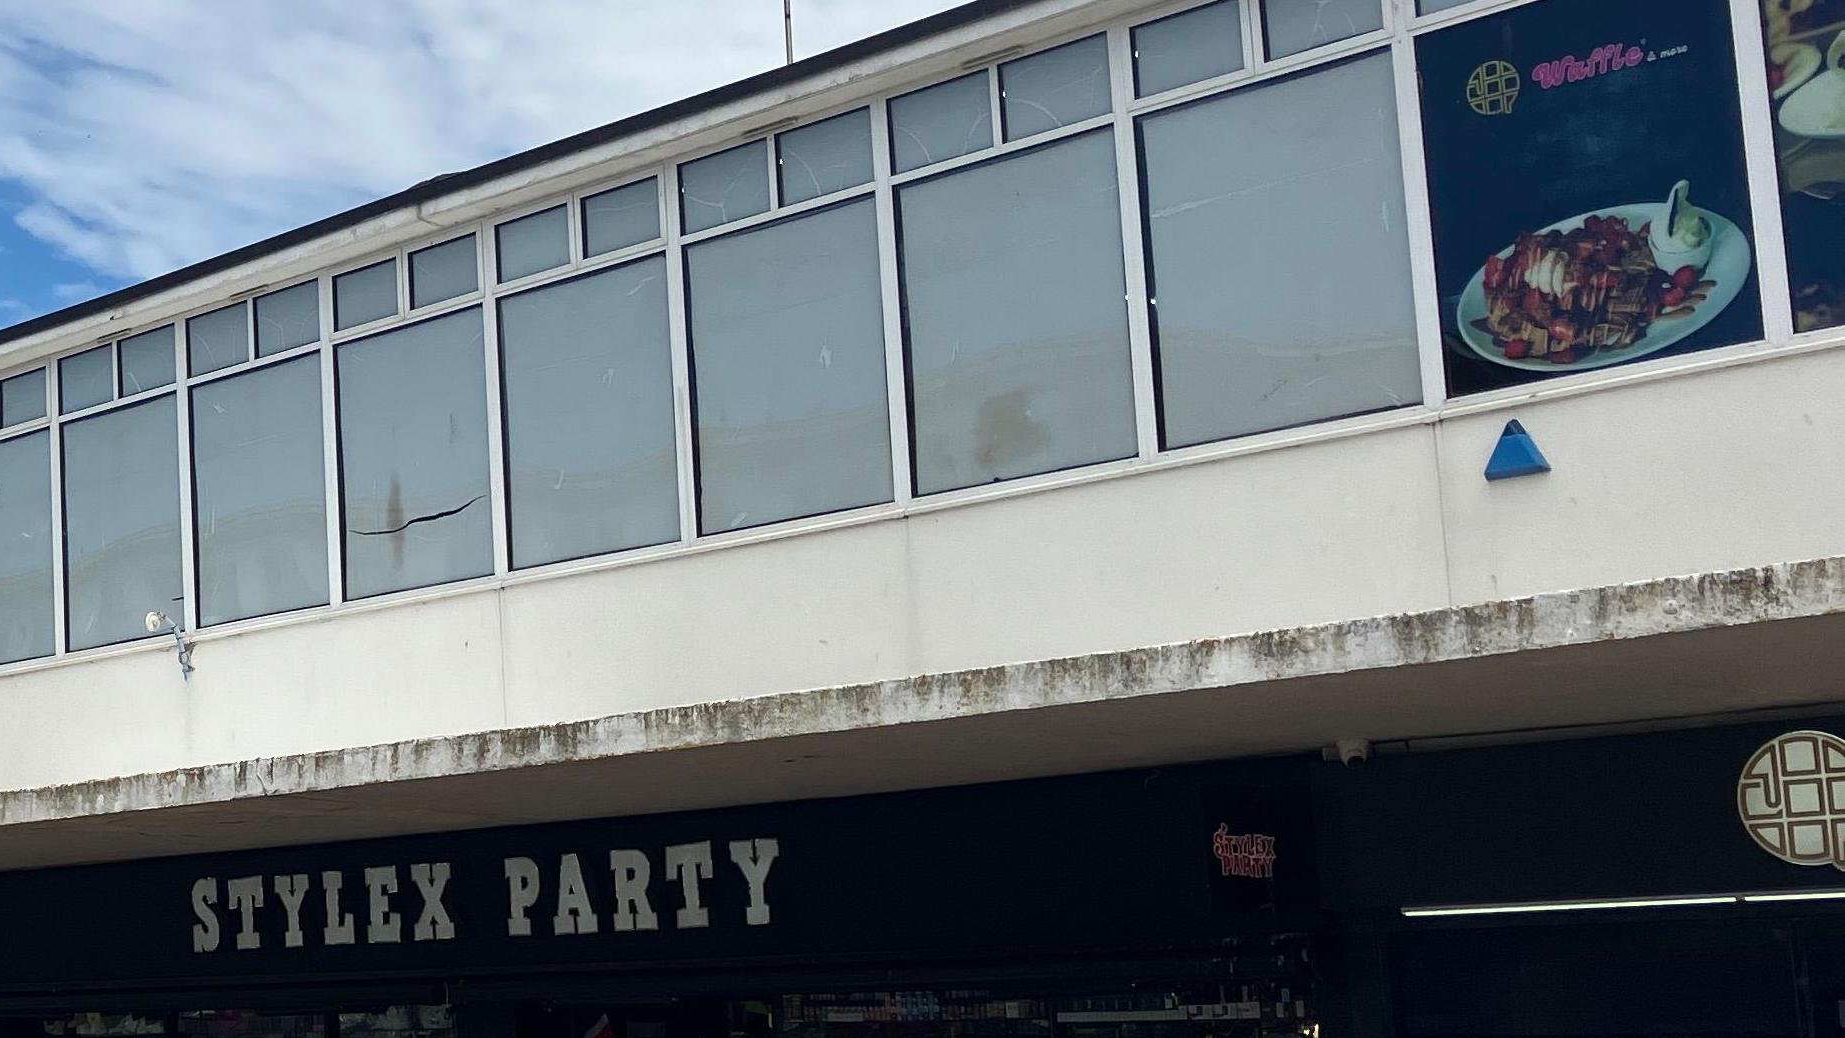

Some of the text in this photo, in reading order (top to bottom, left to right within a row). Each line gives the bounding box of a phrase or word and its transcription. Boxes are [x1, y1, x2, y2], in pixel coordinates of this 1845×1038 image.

[1531, 43, 1644, 90] Waffle
[1213, 823, 1276, 860] STYLEX
[1221, 854, 1274, 878] PARTY
[191, 838, 779, 953] STYLEX PARTY
